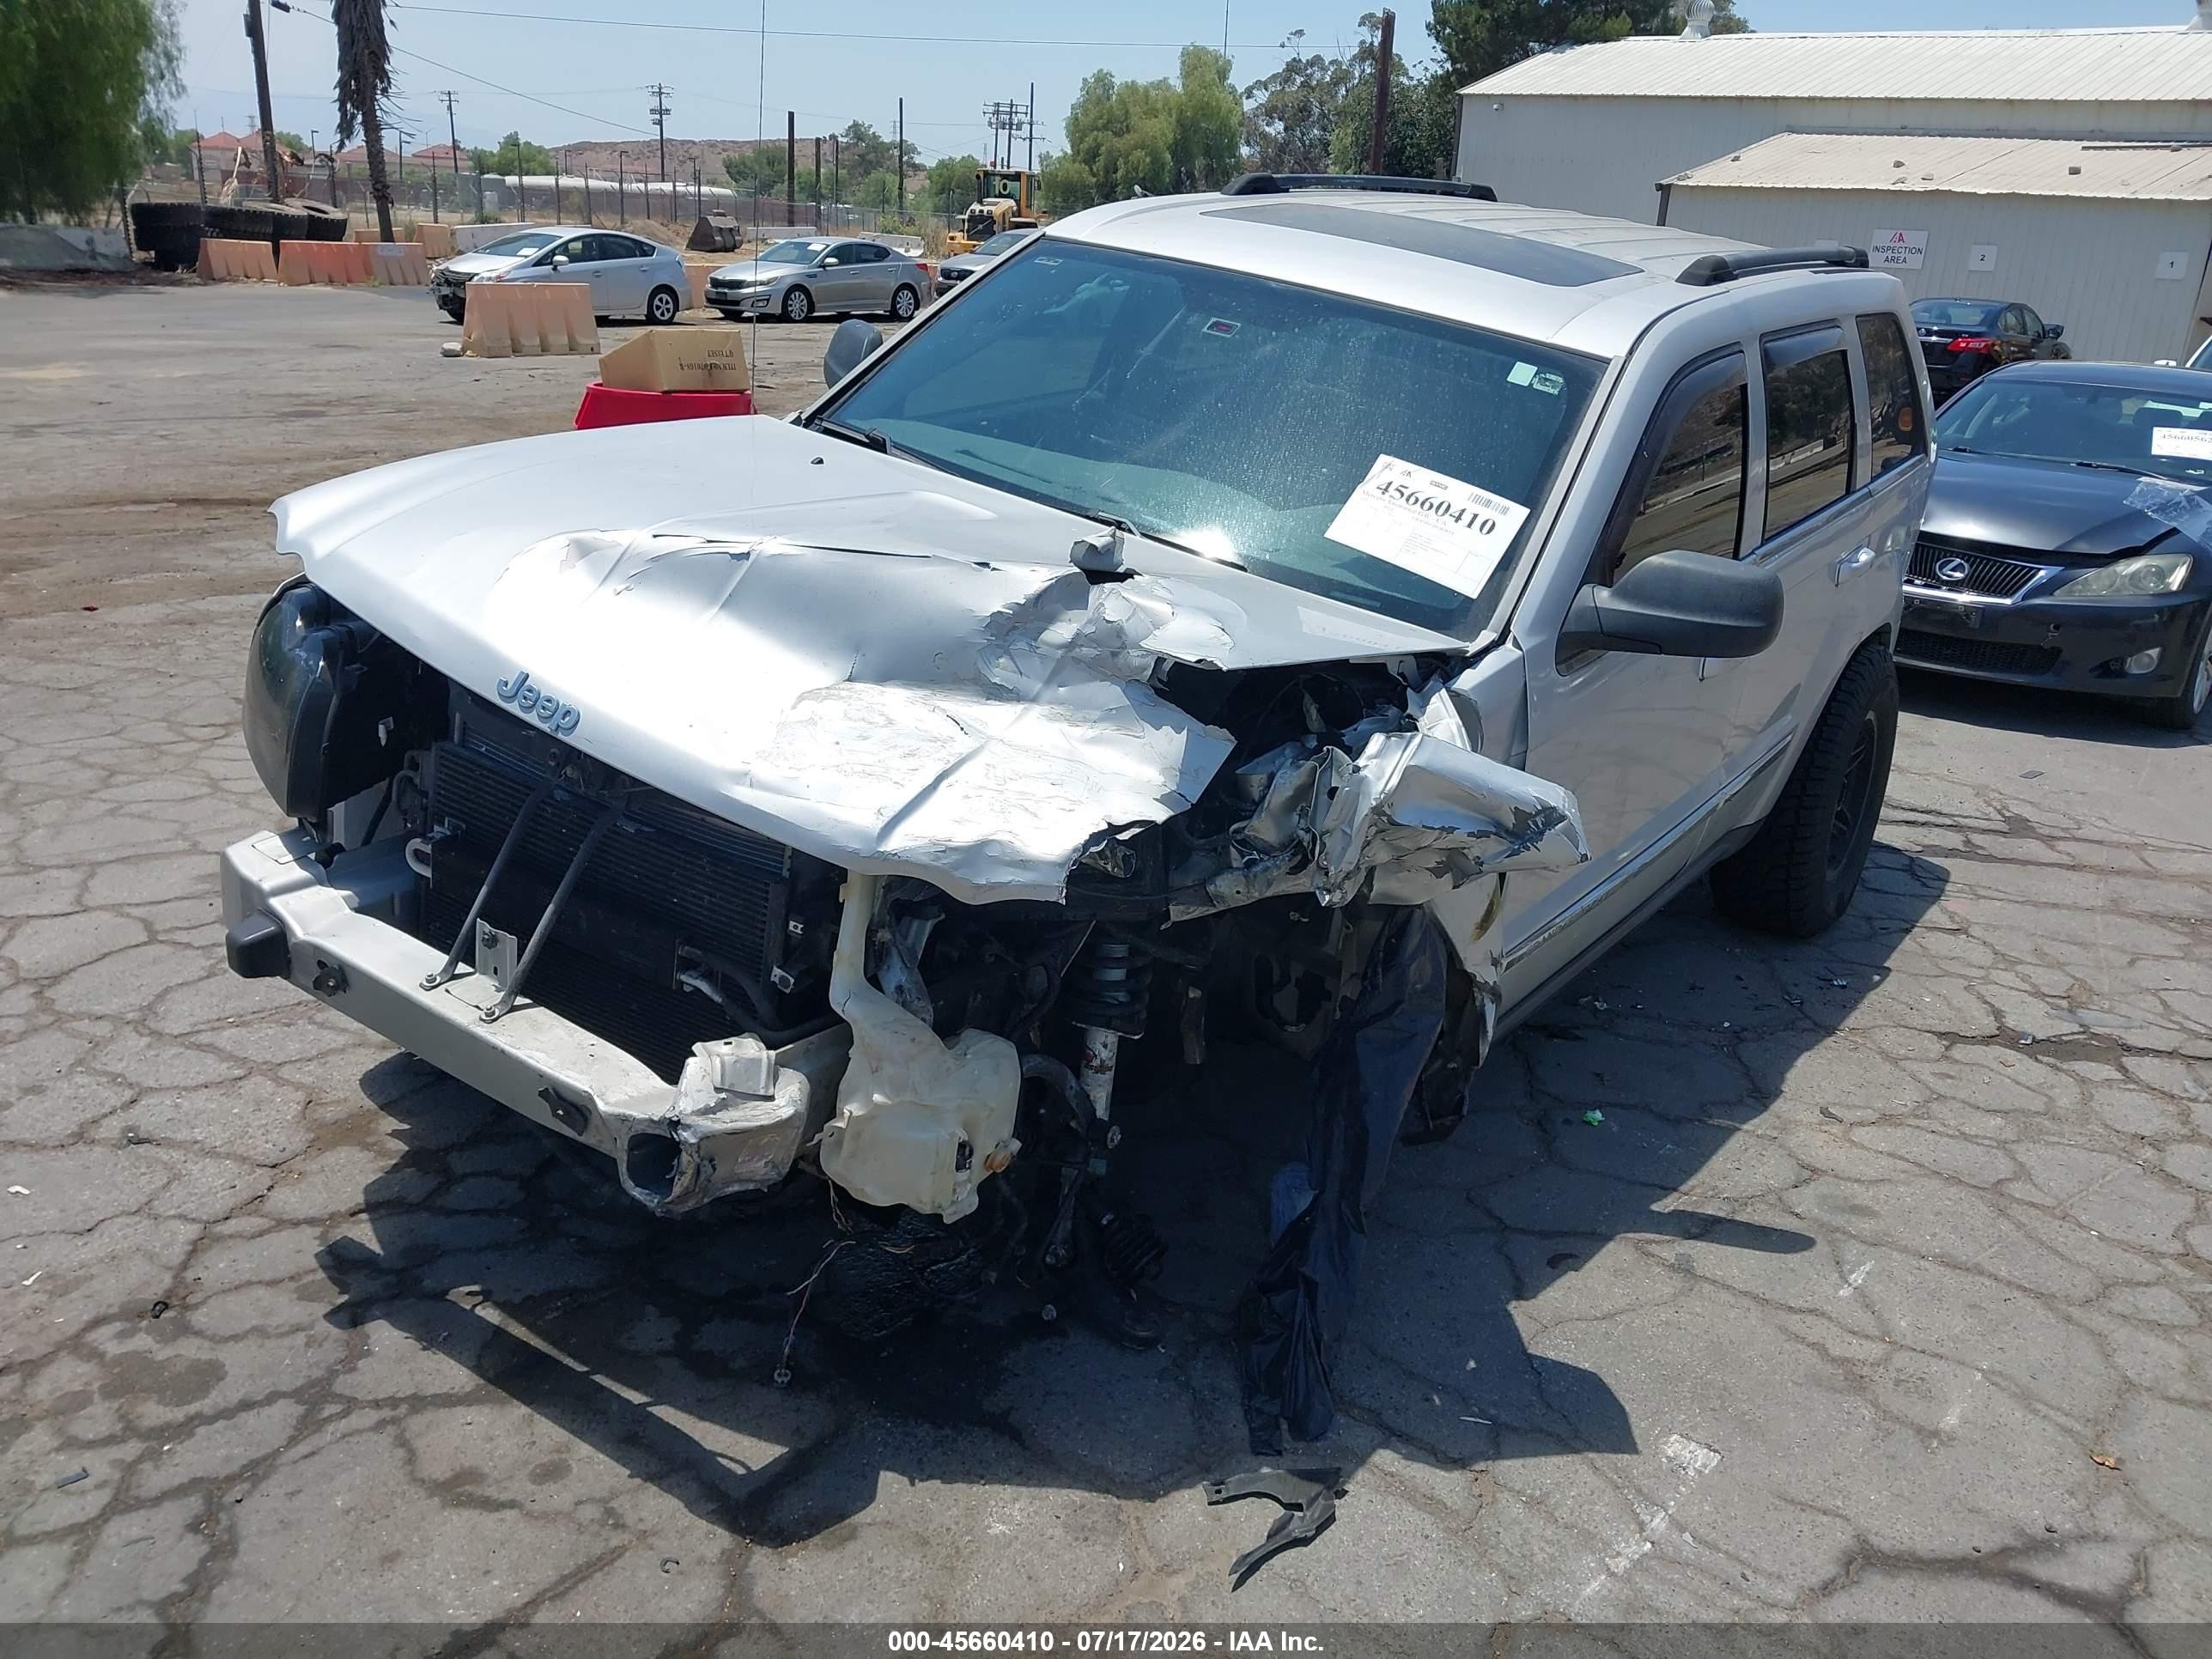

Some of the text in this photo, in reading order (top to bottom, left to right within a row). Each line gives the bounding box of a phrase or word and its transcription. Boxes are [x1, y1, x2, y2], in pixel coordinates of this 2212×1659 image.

[1872, 246, 1923, 255] INSPECTION
[1376, 480, 1497, 536] 45660410
[496, 670, 581, 737] Jeep
